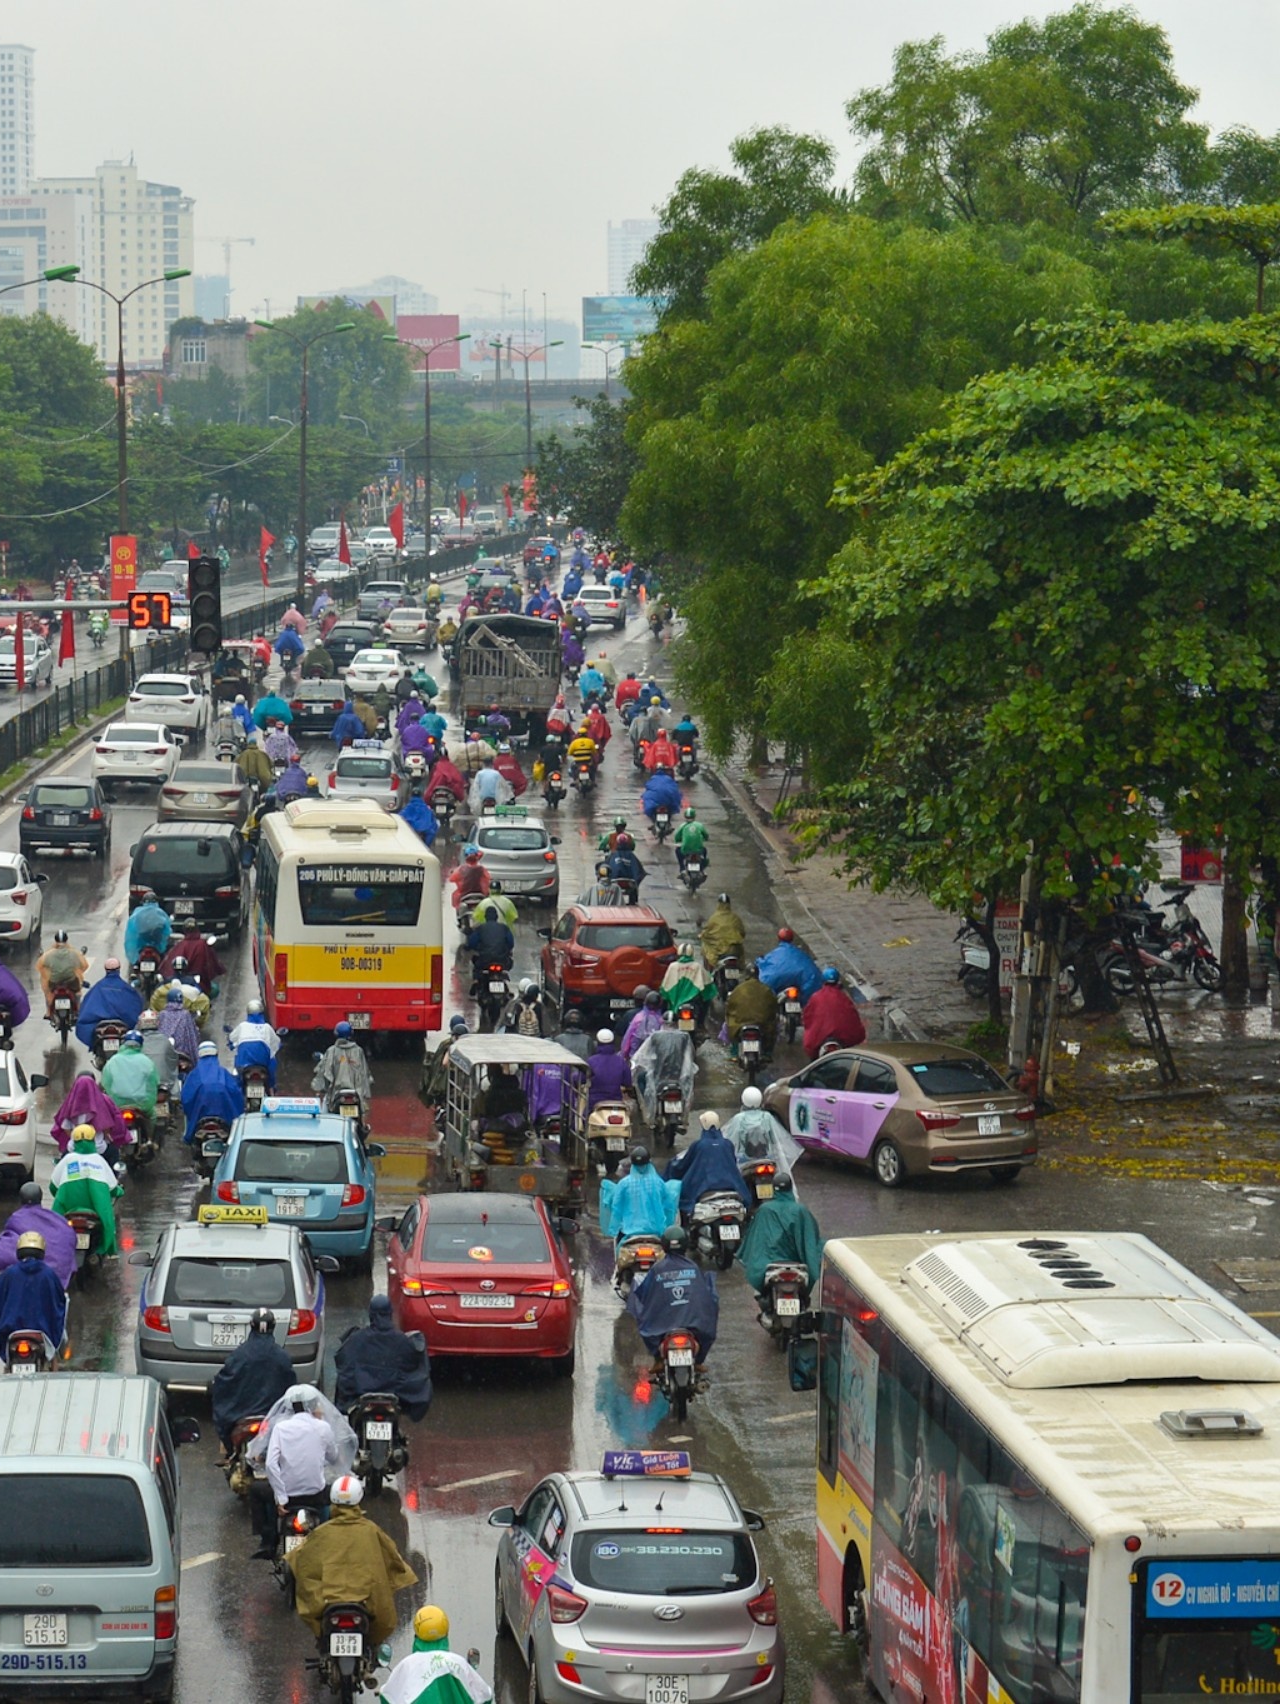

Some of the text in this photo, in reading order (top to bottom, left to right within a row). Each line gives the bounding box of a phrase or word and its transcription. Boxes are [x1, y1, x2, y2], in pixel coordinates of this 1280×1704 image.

[131, 595, 169, 626] 57
[364, 945, 380, 954] GIÁP
[224, 1208, 262, 1216] TAXI
[220, 1324, 237, 1334] 30F
[636, 1546, 723, 1555] 38.230.230
[1155, 1580, 1183, 1598] 12
[34, 1615, 57, 1629] 29D
[25, 1629, 67, 1644] 515.13
[1, 1654, 87, 1671] 29D-515.13
[656, 1676, 679, 1689] 30E
[649, 1690, 687, 1704] 100.76
